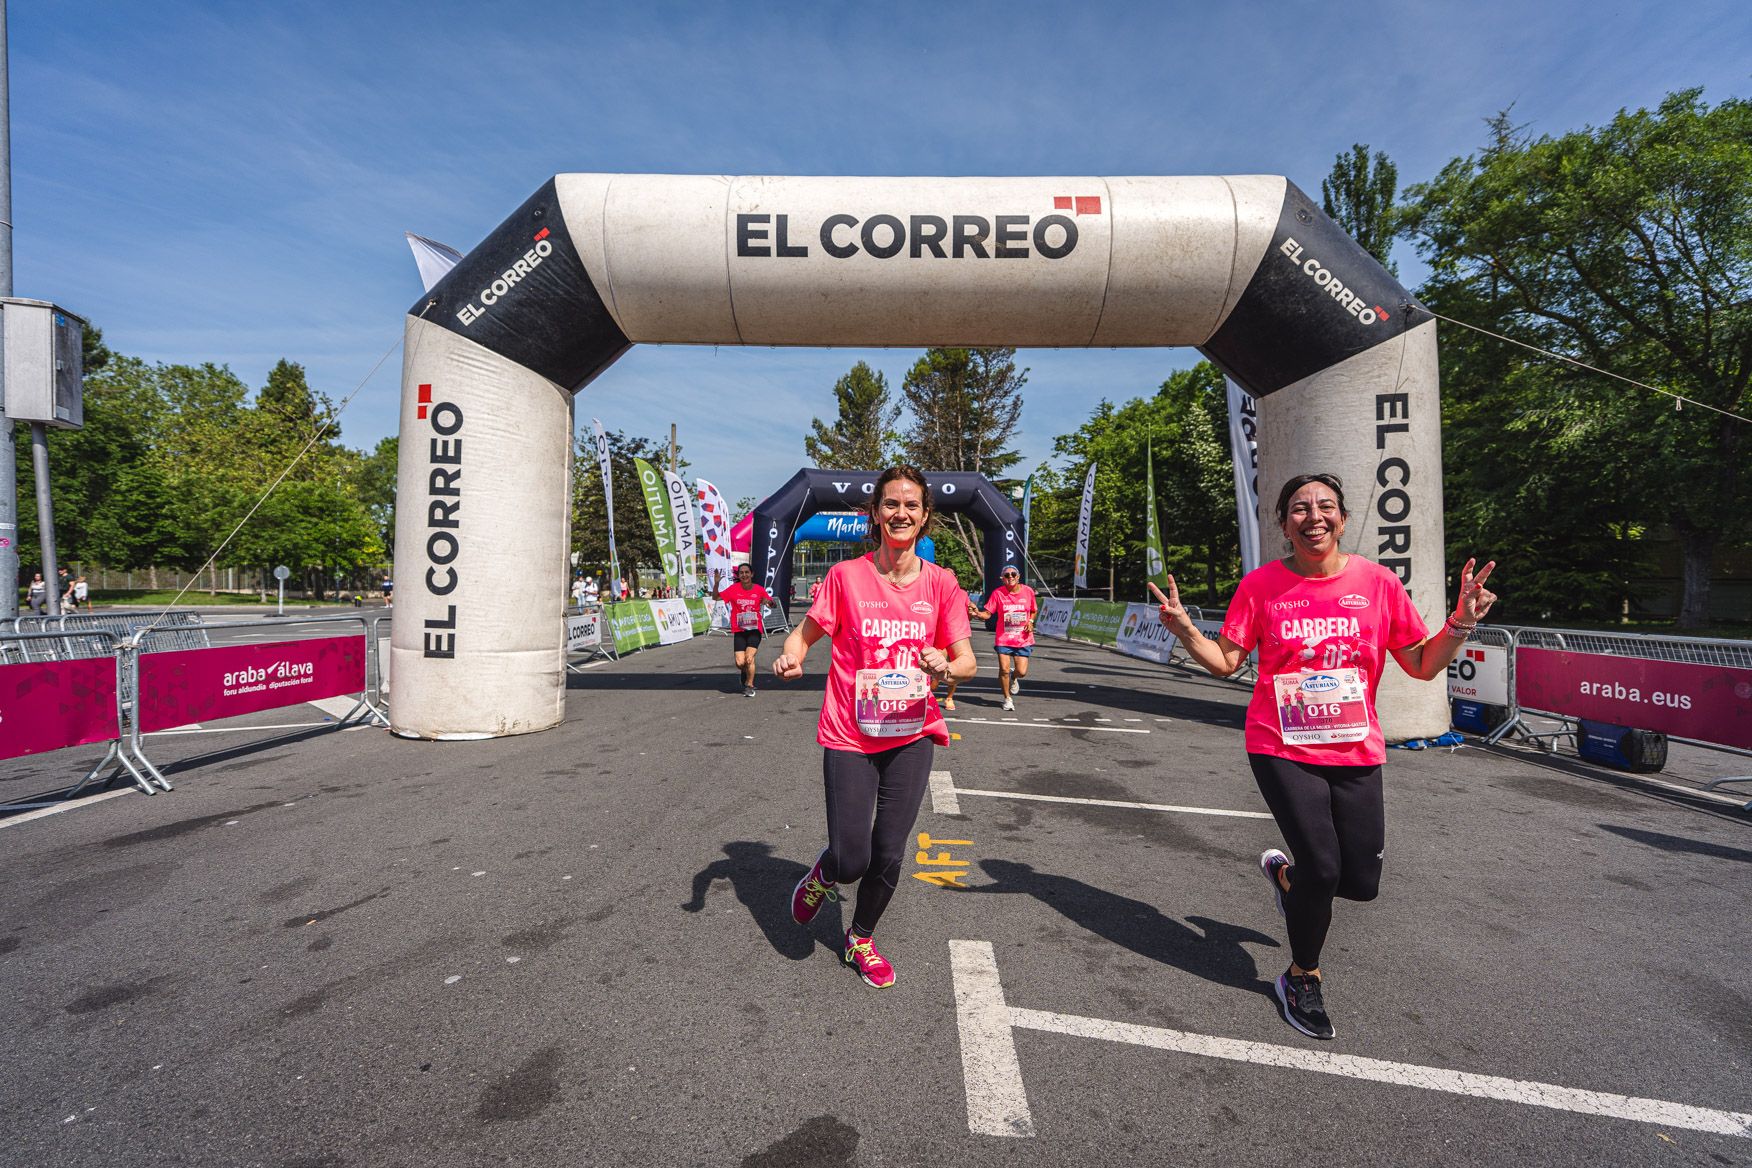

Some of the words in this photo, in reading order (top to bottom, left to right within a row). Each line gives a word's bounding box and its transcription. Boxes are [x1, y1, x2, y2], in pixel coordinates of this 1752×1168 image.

[737, 214, 808, 258] EL
[820, 213, 1080, 259] CORREO
[456, 303, 486, 326] EL
[480, 239, 552, 305] CORREO
[1280, 237, 1304, 266] EL
[1303, 258, 1377, 325] CORREO
[1376, 392, 1409, 450] EL
[425, 401, 464, 596] CORREO
[832, 482, 956, 494] VOO
[1376, 457, 1412, 600] CORR
[858, 600, 889, 609] OYSHO
[1274, 599, 1310, 610] OYSHO
[423, 605, 456, 659] EL
[573, 623, 595, 640] CORREO
[862, 618, 927, 640] CARRERA
[1281, 617, 1361, 639] CARRERA
[223, 666, 266, 686] araba
[277, 661, 314, 678] álava
[223, 688, 237, 696] foru
[238, 684, 267, 694] aldundia
[269, 678, 300, 690] diputación
[300, 676, 314, 684] foral
[1451, 686, 1477, 697] VALOR
[1580, 681, 1692, 709] araba.eus
[880, 700, 907, 711] 016
[1307, 703, 1341, 717] 016
[1292, 733, 1321, 741] OYSHO
